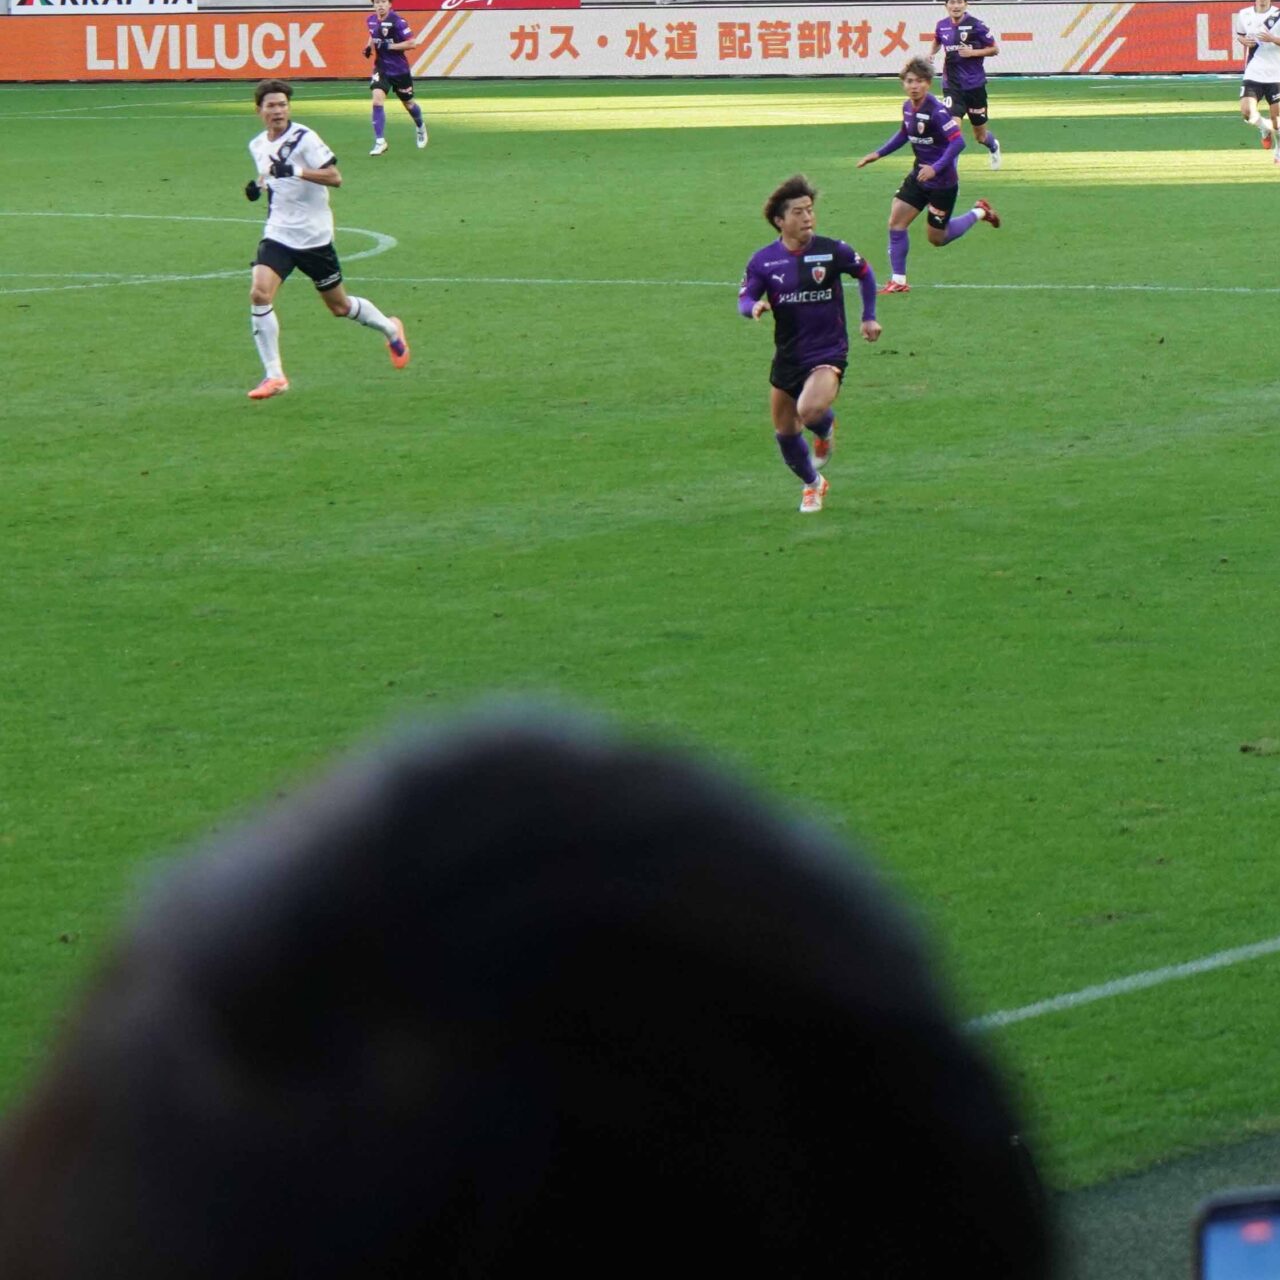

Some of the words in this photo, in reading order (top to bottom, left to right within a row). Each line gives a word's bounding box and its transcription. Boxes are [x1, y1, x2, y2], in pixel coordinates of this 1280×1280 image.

[86, 22, 327, 71] LIVILUCK
[509, 22, 698, 62] ガス・水道
